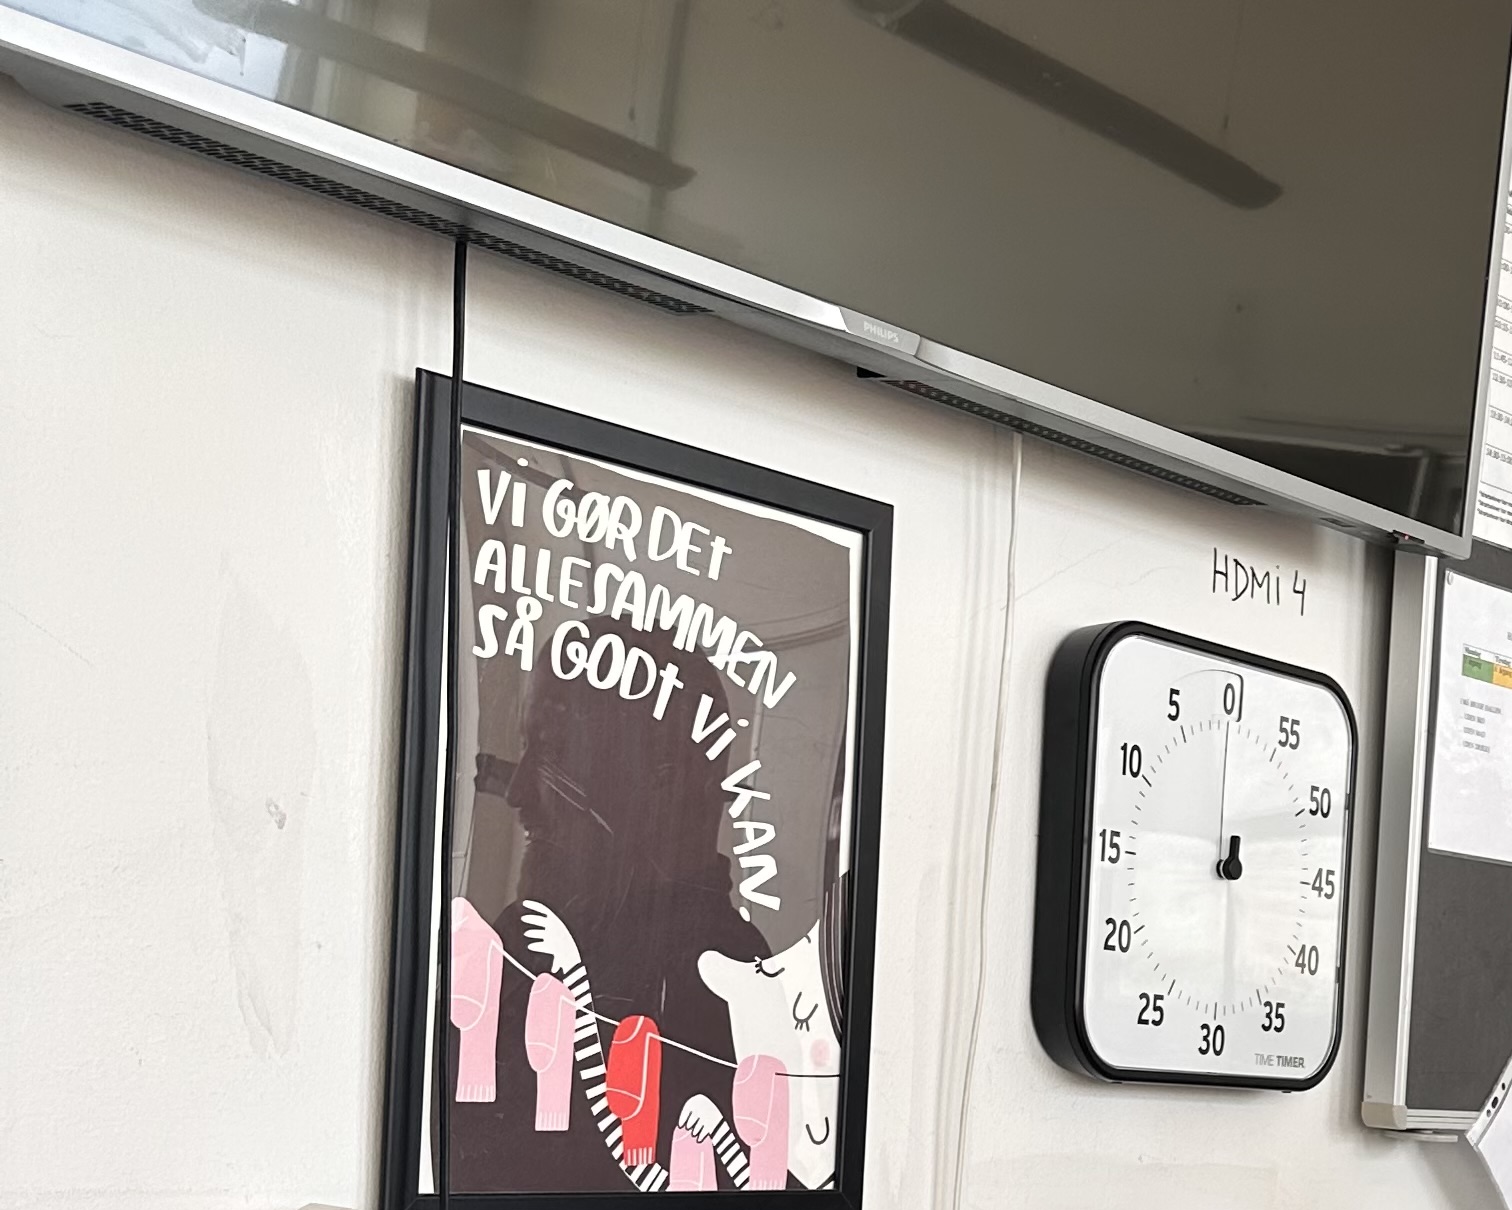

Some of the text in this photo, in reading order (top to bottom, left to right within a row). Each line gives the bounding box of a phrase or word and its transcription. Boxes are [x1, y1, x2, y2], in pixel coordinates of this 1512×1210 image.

[863, 320, 900, 344] PHILIPS
[541, 478, 643, 563] GØR
[1292, 569, 1307, 617] 4
[471, 595, 544, 672] SÅ
[1167, 688, 1181, 721] 5
[1223, 682, 1236, 716] 0
[1277, 716, 1301, 751] 55
[1120, 742, 1142, 778] 10
[1309, 785, 1332, 818] 50
[1099, 829, 1121, 865] 15
[1311, 868, 1336, 900] 45
[1103, 917, 1132, 953] 20
[1295, 943, 1320, 977] 40
[1136, 992, 1165, 1028] 25
[1261, 1000, 1286, 1033] 35
[1198, 1023, 1225, 1057] 30
[1254, 1053, 1305, 1068] TIME TIMER
